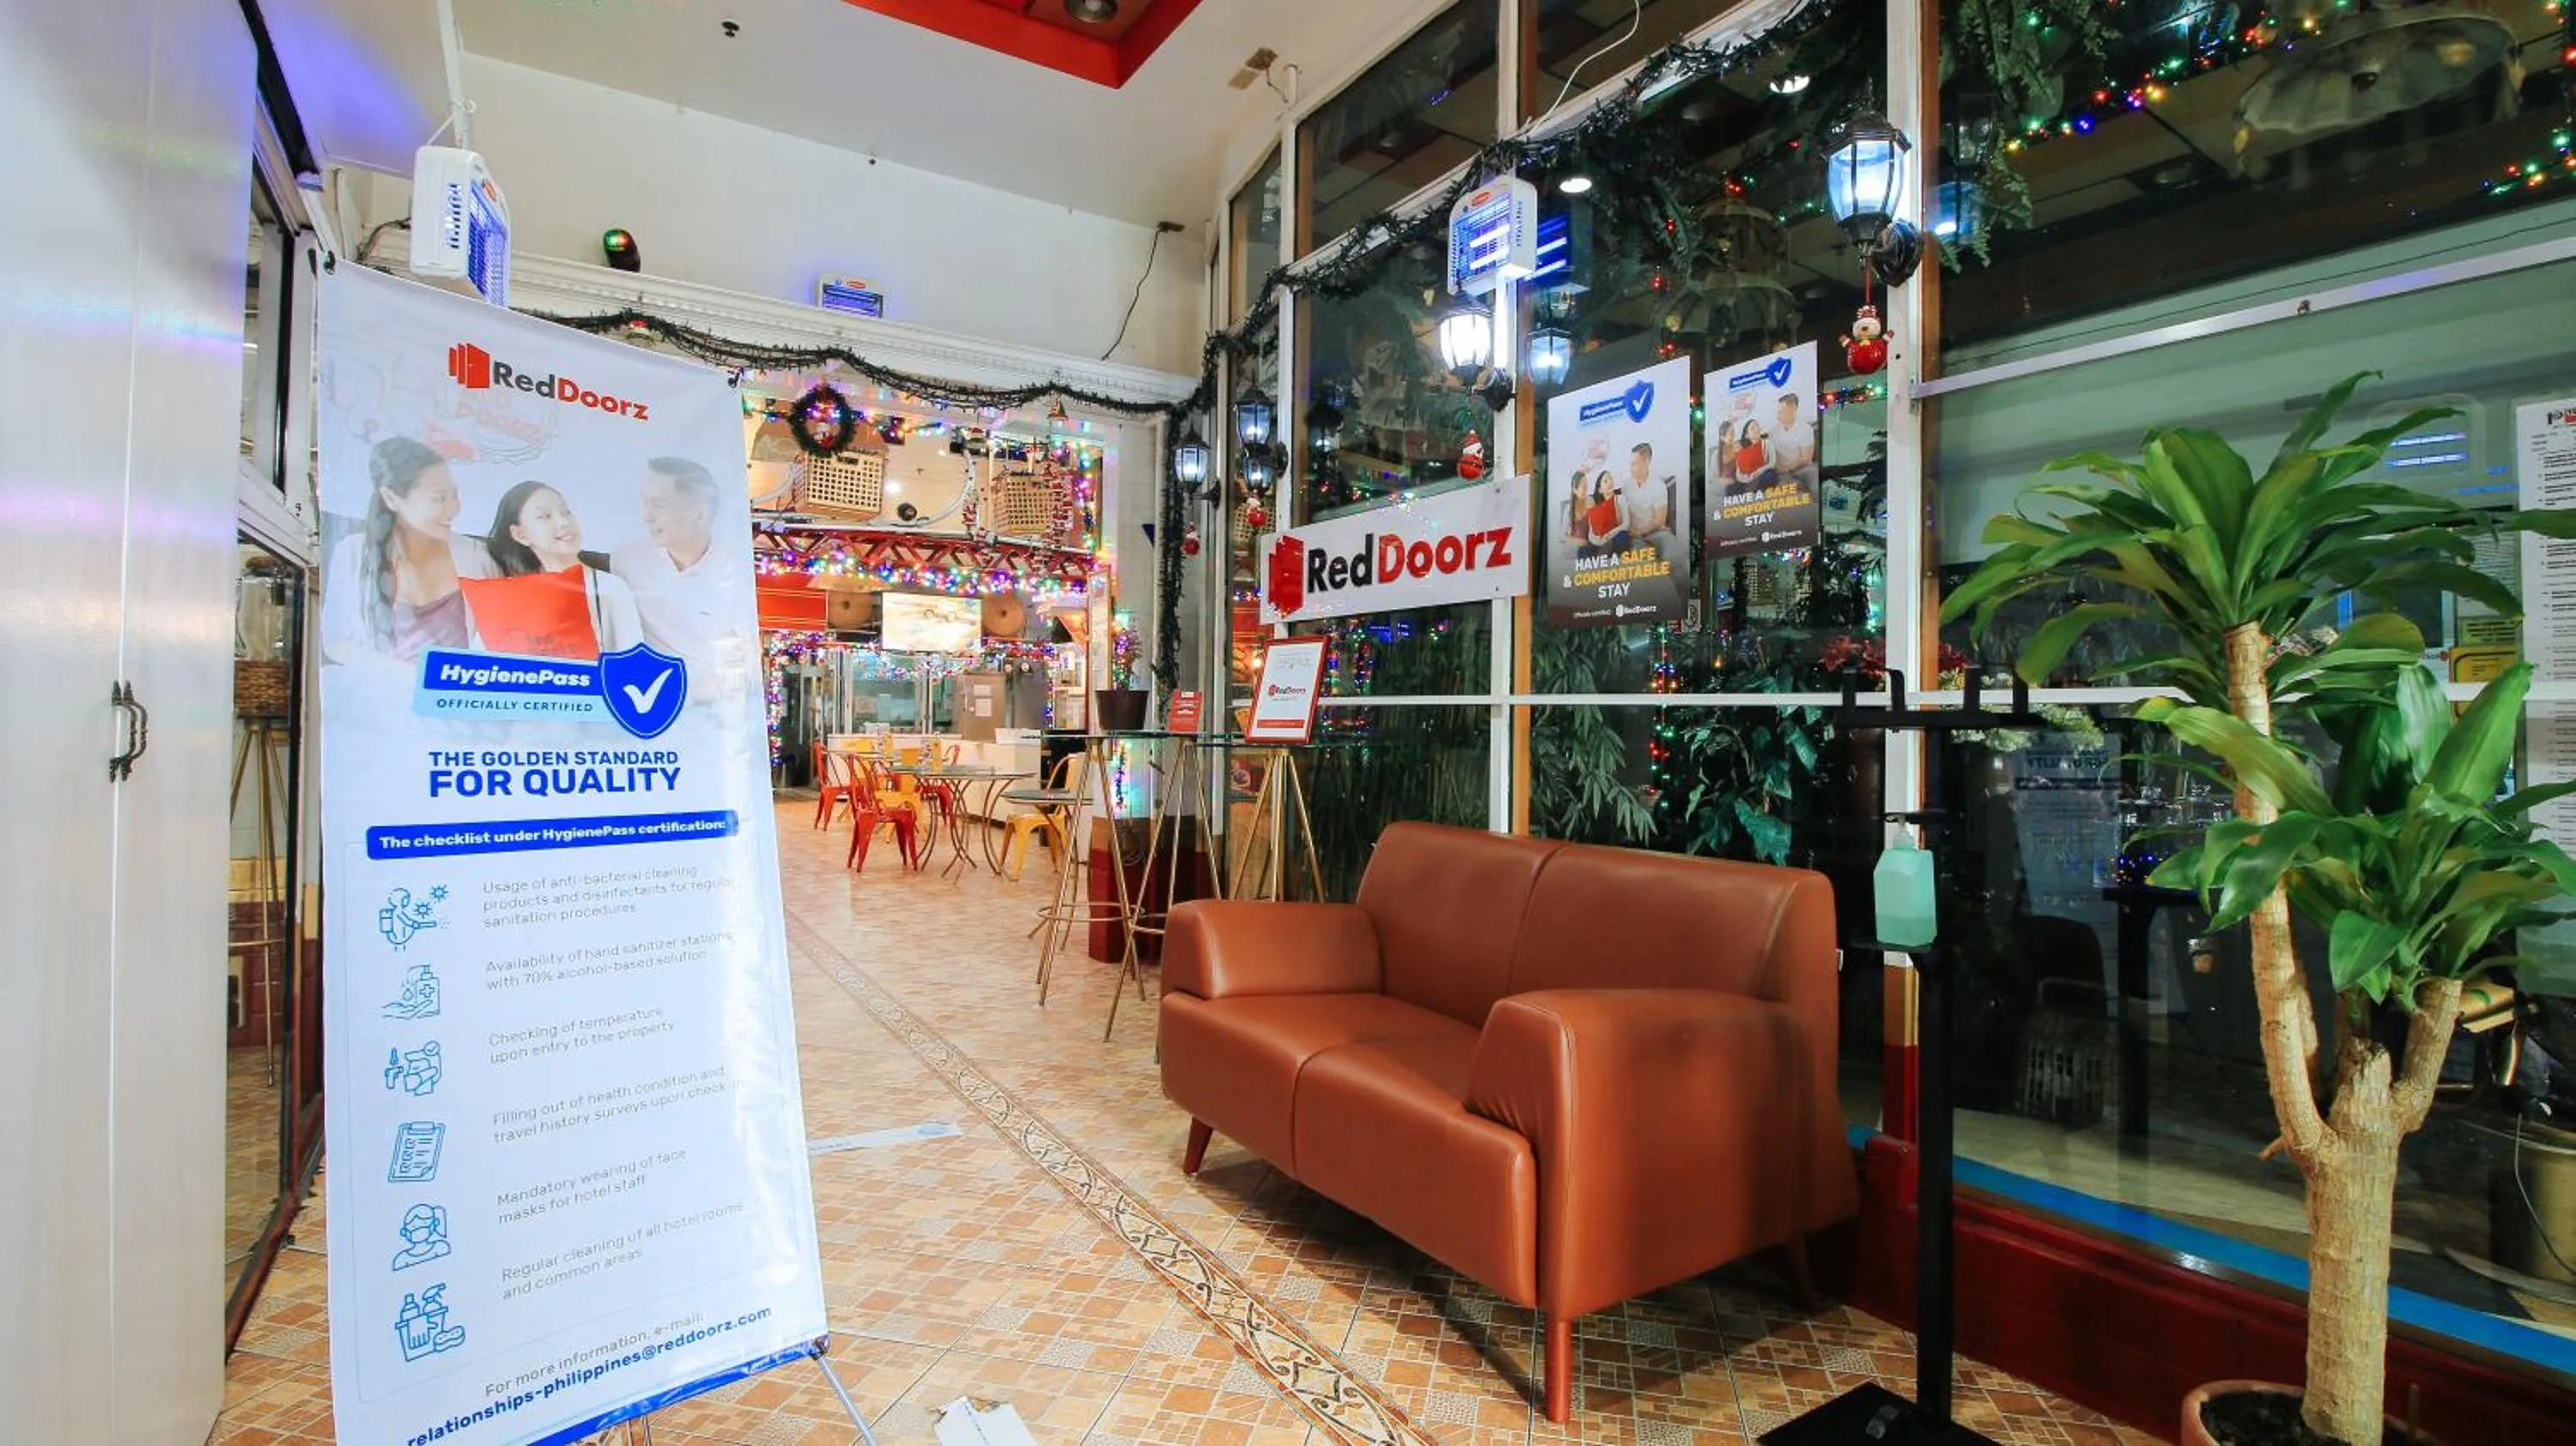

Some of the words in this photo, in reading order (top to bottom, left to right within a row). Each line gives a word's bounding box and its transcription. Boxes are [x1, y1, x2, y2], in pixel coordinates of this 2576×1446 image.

[493, 361, 648, 421] RedDoorz
[1724, 492, 1753, 507] HAVE
[1755, 489, 1764, 501] A
[1765, 481, 1797, 496] SAFE
[1745, 512, 1774, 526] STAY
[1307, 526, 1512, 593] RedDoorz
[1564, 574, 1572, 588] &
[1574, 561, 1671, 586] COMFORTABLE
[1576, 554, 1608, 571] HAVE
[1610, 552, 1620, 566] A
[1620, 547, 1656, 564] SAFE
[1598, 582, 1631, 598] STAY
[440, 664, 591, 688] HygienePass
[437, 698, 518, 711] OFFICIALLY
[523, 702, 593, 713] CERTIFIED
[429, 751, 475, 767] THE
[482, 751, 569, 767] GOLDEN
[574, 750, 678, 765] STANDARD
[430, 769, 513, 797] FOR
[524, 767, 681, 797] QUALITY
[380, 836, 411, 849] The
[414, 831, 491, 848] checklist
[494, 829, 540, 843] under
[543, 824, 635, 841] HygienePass
[483, 881, 529, 894] Usage
[532, 877, 547, 890] of
[550, 870, 641, 889] anti-bacterial
[645, 866, 699, 881] cleaning
[483, 894, 549, 914] products
[552, 893, 579, 904] and
[582, 884, 667, 902] disinfectants
[671, 881, 688, 892] for
[484, 909, 557, 927] sanitation
[561, 902, 636, 921] procedures
[486, 952, 564, 972] Availability
[568, 948, 582, 963] of
[586, 944, 619, 959] hand
[623, 938, 677, 954] sanitizer
[487, 975, 519, 990] with
[523, 970, 553, 984] 70%
[557, 957, 653, 980] alcohol-based
[656, 949, 708, 965] solution
[489, 1025, 557, 1047] Checking
[562, 1021, 575, 1034] of
[579, 1007, 663, 1030] temperature
[490, 1047, 528, 1065] upon
[532, 1039, 569, 1057] entry
[574, 1036, 588, 1048] to
[592, 1032, 615, 1045] the
[618, 1022, 674, 1041] property
[494, 1108, 537, 1126] Filling
[541, 1101, 566, 1115] out
[569, 1094, 584, 1109] of
[587, 1085, 632, 1105] health
[635, 1072, 698, 1095] condition
[701, 1065, 725, 1080] and
[495, 1123, 538, 1143] travel
[540, 1114, 591, 1133] history
[595, 1100, 647, 1120] surveys
[650, 1091, 684, 1109] upon
[497, 1176, 577, 1206] Mandatory
[580, 1162, 636, 1184] wearing
[640, 1155, 653, 1169] of
[657, 1150, 686, 1163] face
[499, 1203, 547, 1224] masks
[550, 1196, 571, 1210] for
[574, 1183, 611, 1202] hotel
[614, 1174, 646, 1193] staff
[502, 1255, 558, 1282] Regular
[563, 1236, 624, 1263] cleaning
[628, 1228, 642, 1242] of
[646, 1222, 661, 1237] all
[664, 1212, 700, 1232] hotel
[502, 1280, 532, 1300] and
[535, 1261, 601, 1289] common
[605, 1249, 642, 1267] areas
[407, 1307, 772, 1446] relationships-philippines@reddoorz.com
[485, 1379, 512, 1397] For
[515, 1363, 556, 1388] more
